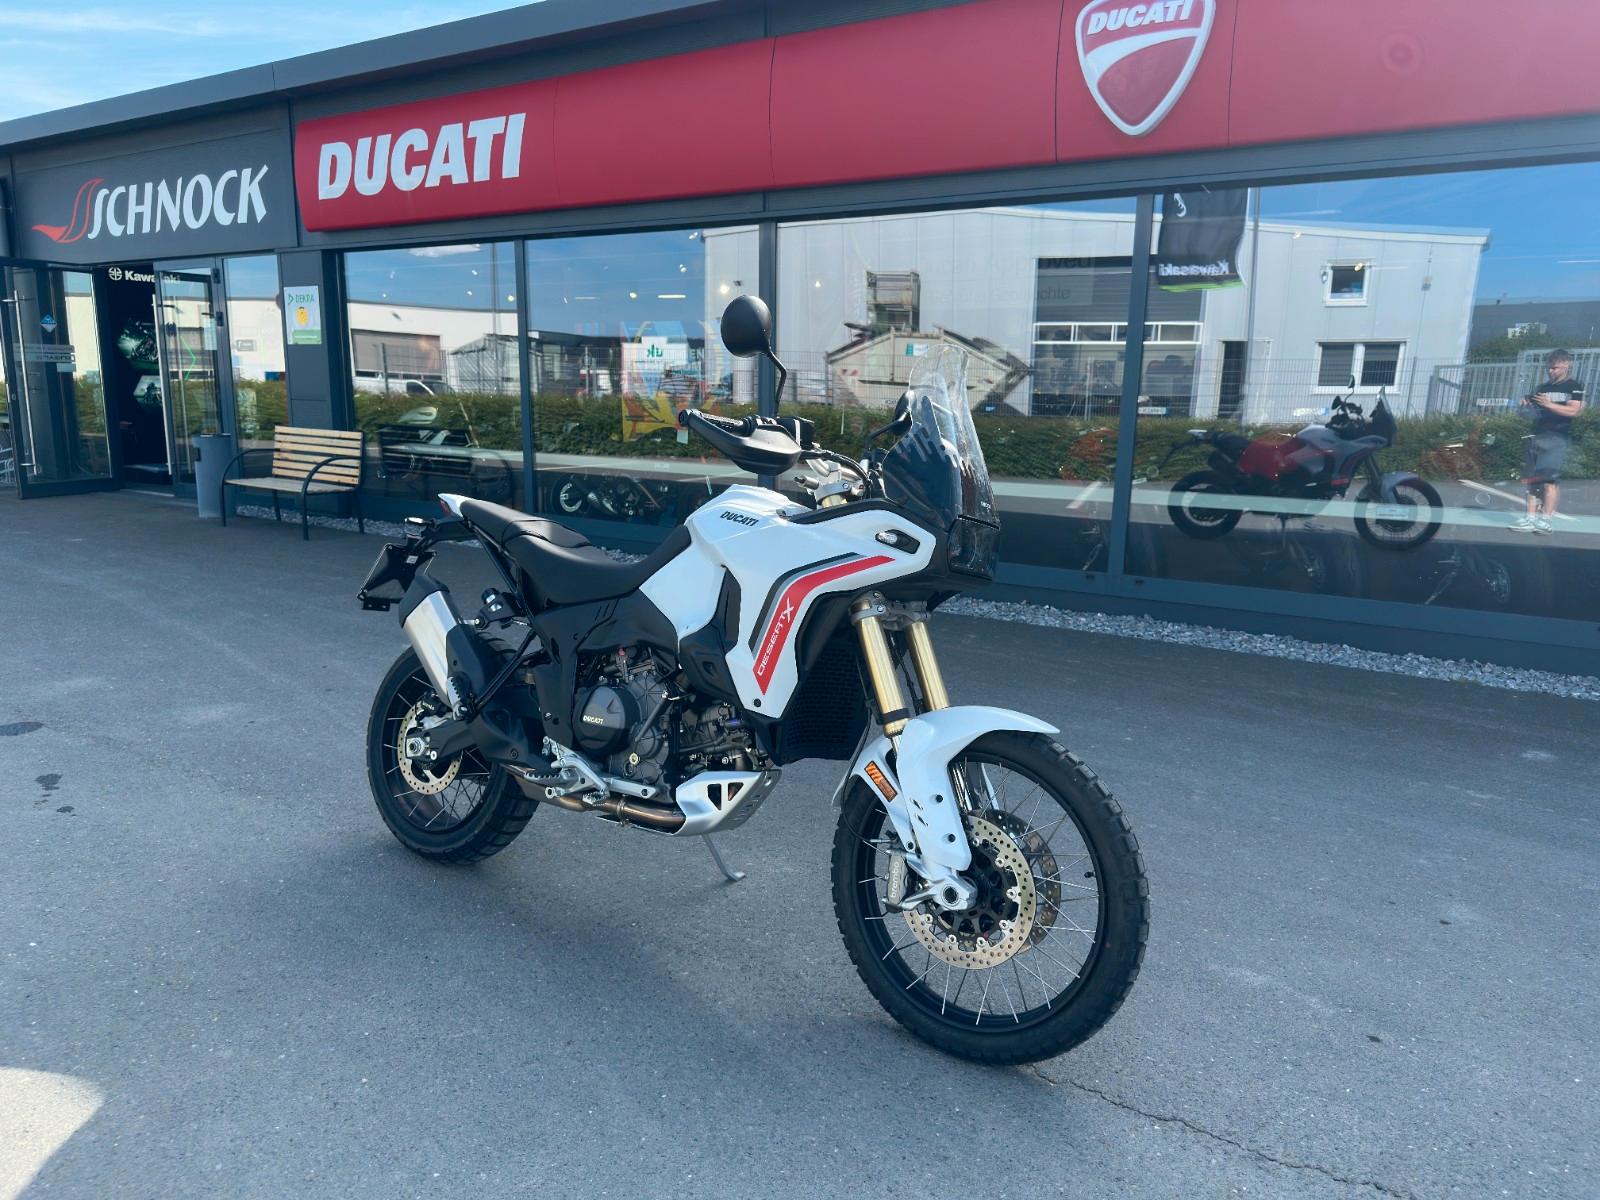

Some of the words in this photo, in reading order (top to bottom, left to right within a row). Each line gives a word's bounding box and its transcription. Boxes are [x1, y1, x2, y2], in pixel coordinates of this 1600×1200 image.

[1087, 0, 1194, 35] DUCATI
[318, 112, 527, 200] DUCATI
[87, 164, 269, 240] SCHNOCK
[124, 270, 180, 284] Kawaaki
[720, 510, 760, 527] DUCATI
[890, 861, 900, 898] brembo
